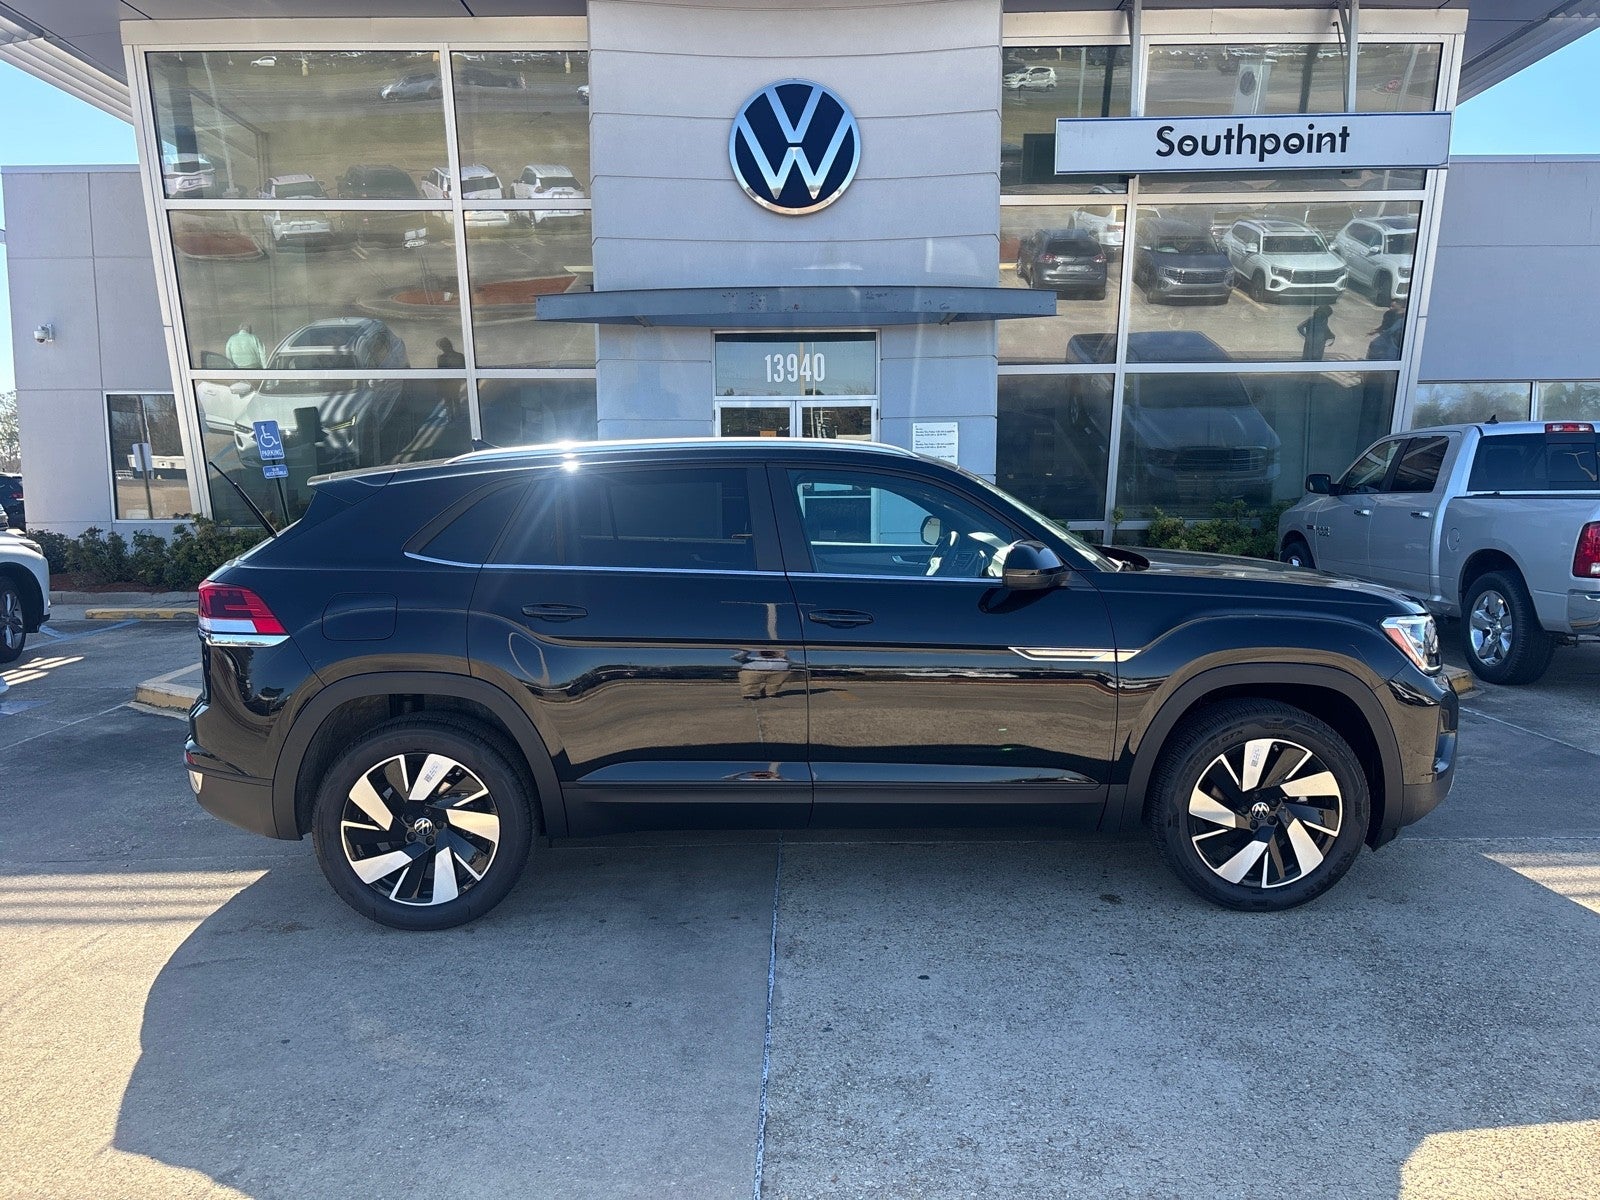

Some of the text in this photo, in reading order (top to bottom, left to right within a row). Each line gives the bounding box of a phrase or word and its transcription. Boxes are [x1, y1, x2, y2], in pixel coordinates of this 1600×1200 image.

[729, 78, 861, 215] VW
[1156, 123, 1350, 162] Southpoint
[764, 353, 826, 383] 13940
[261, 449, 283, 457] PARKING
